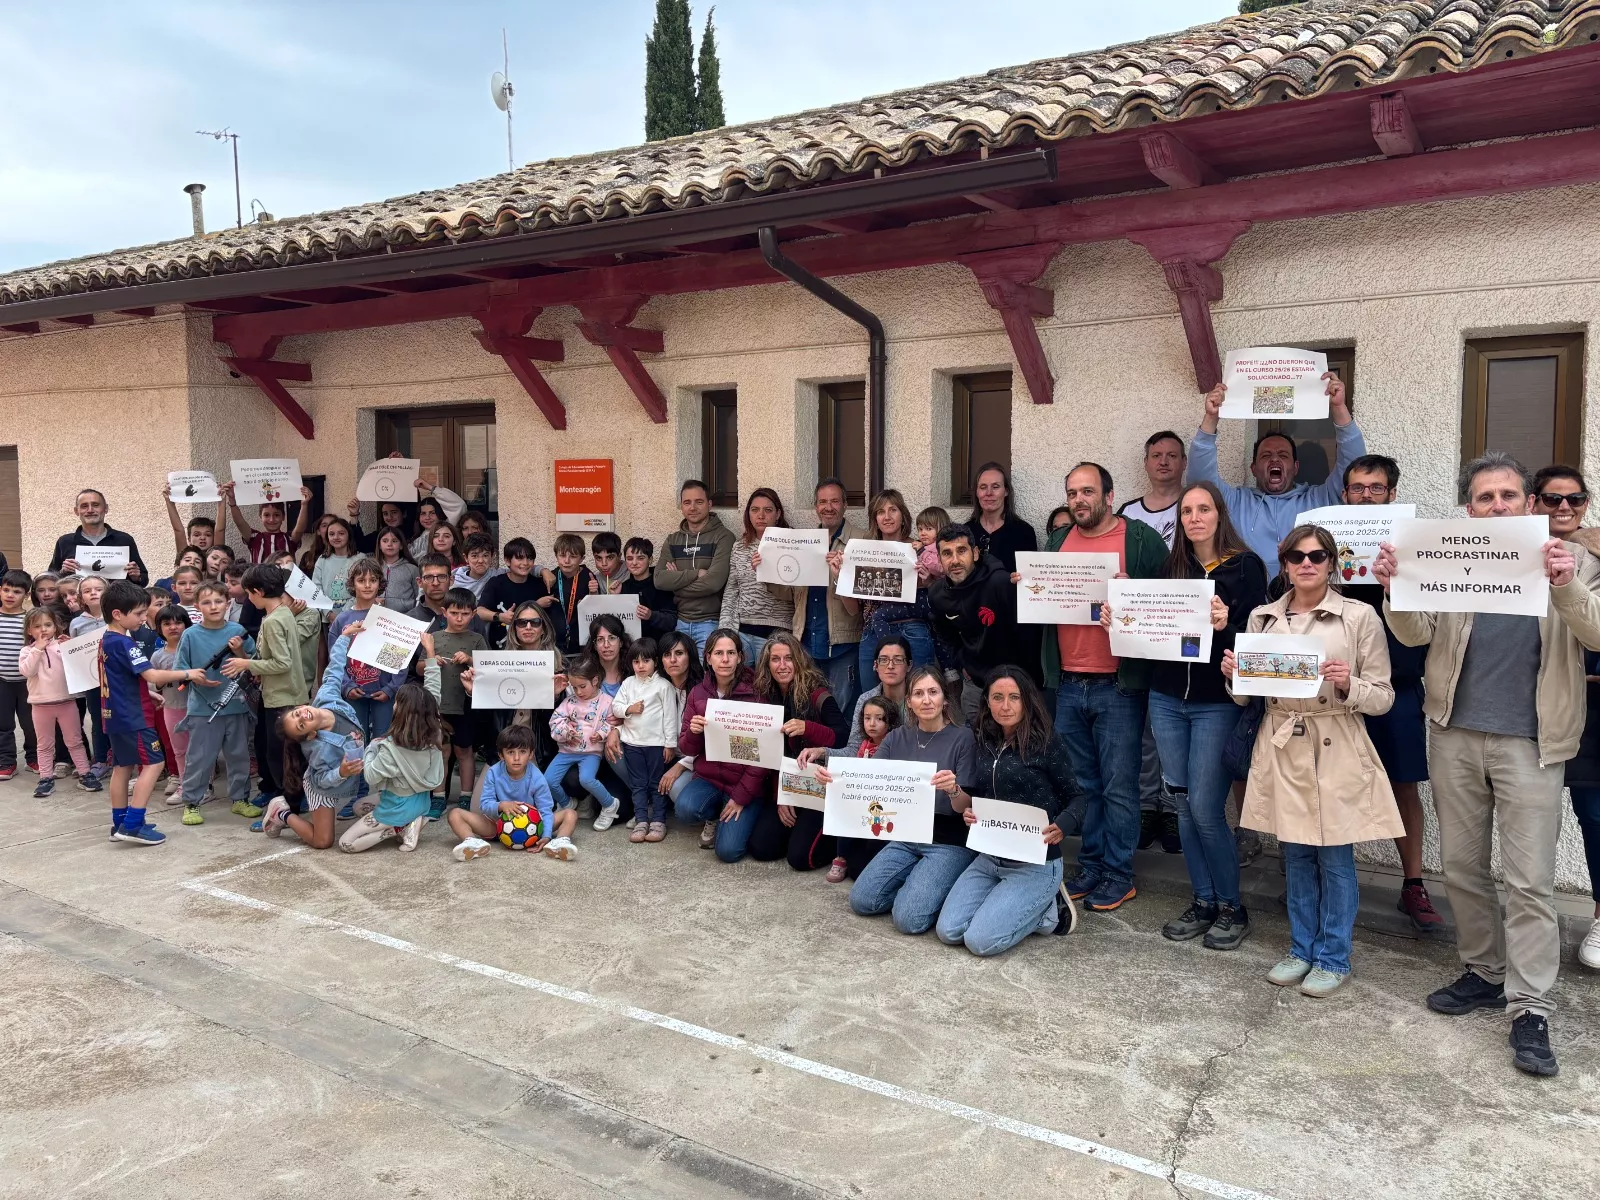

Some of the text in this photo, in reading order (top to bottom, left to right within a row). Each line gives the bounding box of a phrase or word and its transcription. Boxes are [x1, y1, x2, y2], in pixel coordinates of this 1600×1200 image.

[560, 486, 601, 494] Montearagón
[1442, 536, 1490, 545] MENOS
[1417, 550, 1520, 560] PROCRASTINAR
[1464, 567, 1471, 575] Y
[1420, 581, 1521, 594] MÁS INFORMAR
[389, 627, 405, 635] CURSO
[69, 646, 84, 654] OBRAS
[841, 770, 874, 779] Podemos
[885, 784, 914, 793] 2025/26
[981, 820, 1040, 834] ¡¡¡BASTA YA!!!
